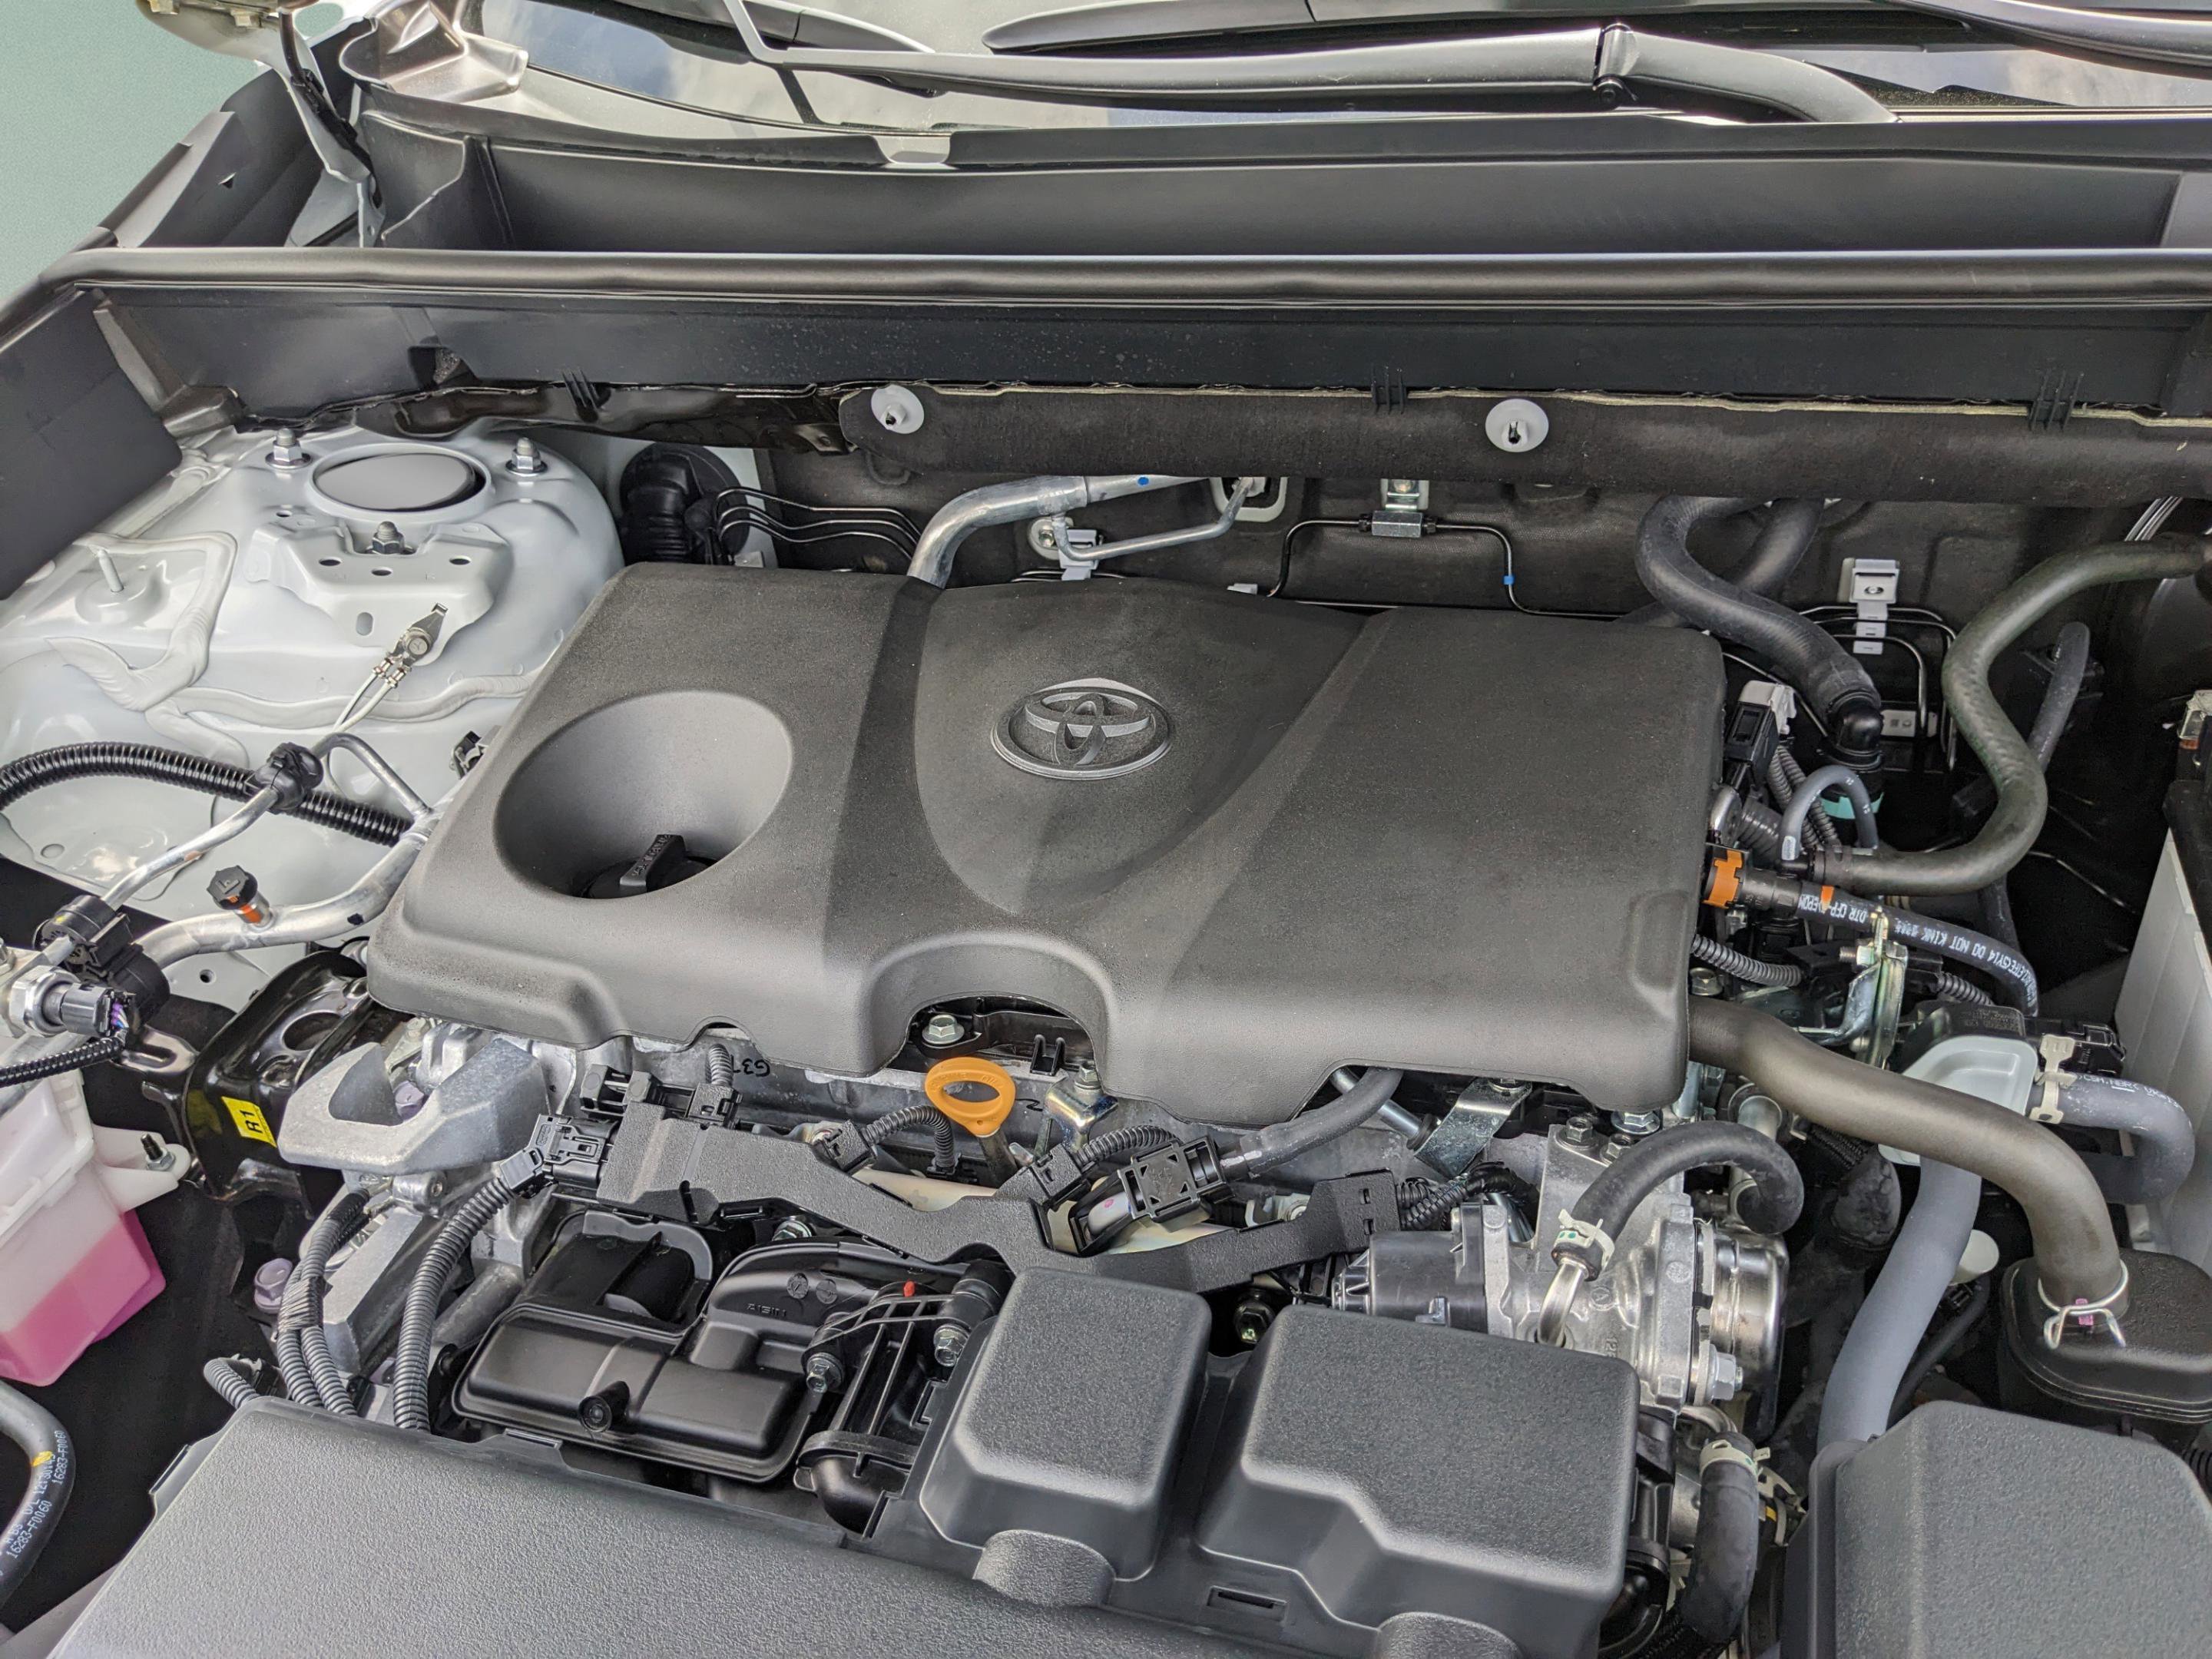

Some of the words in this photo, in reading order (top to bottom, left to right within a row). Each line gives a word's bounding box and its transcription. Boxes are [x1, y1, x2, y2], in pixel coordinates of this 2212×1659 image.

[1920, 926, 1948, 947] KINK
[1948, 935, 1969, 954] NOT
[1971, 943, 1987, 959] DO
[240, 1109, 263, 1134] R1
[5, 1499, 52, 1560] 16283-F0060
[51, 1429, 68, 1485] 16283-F0060
